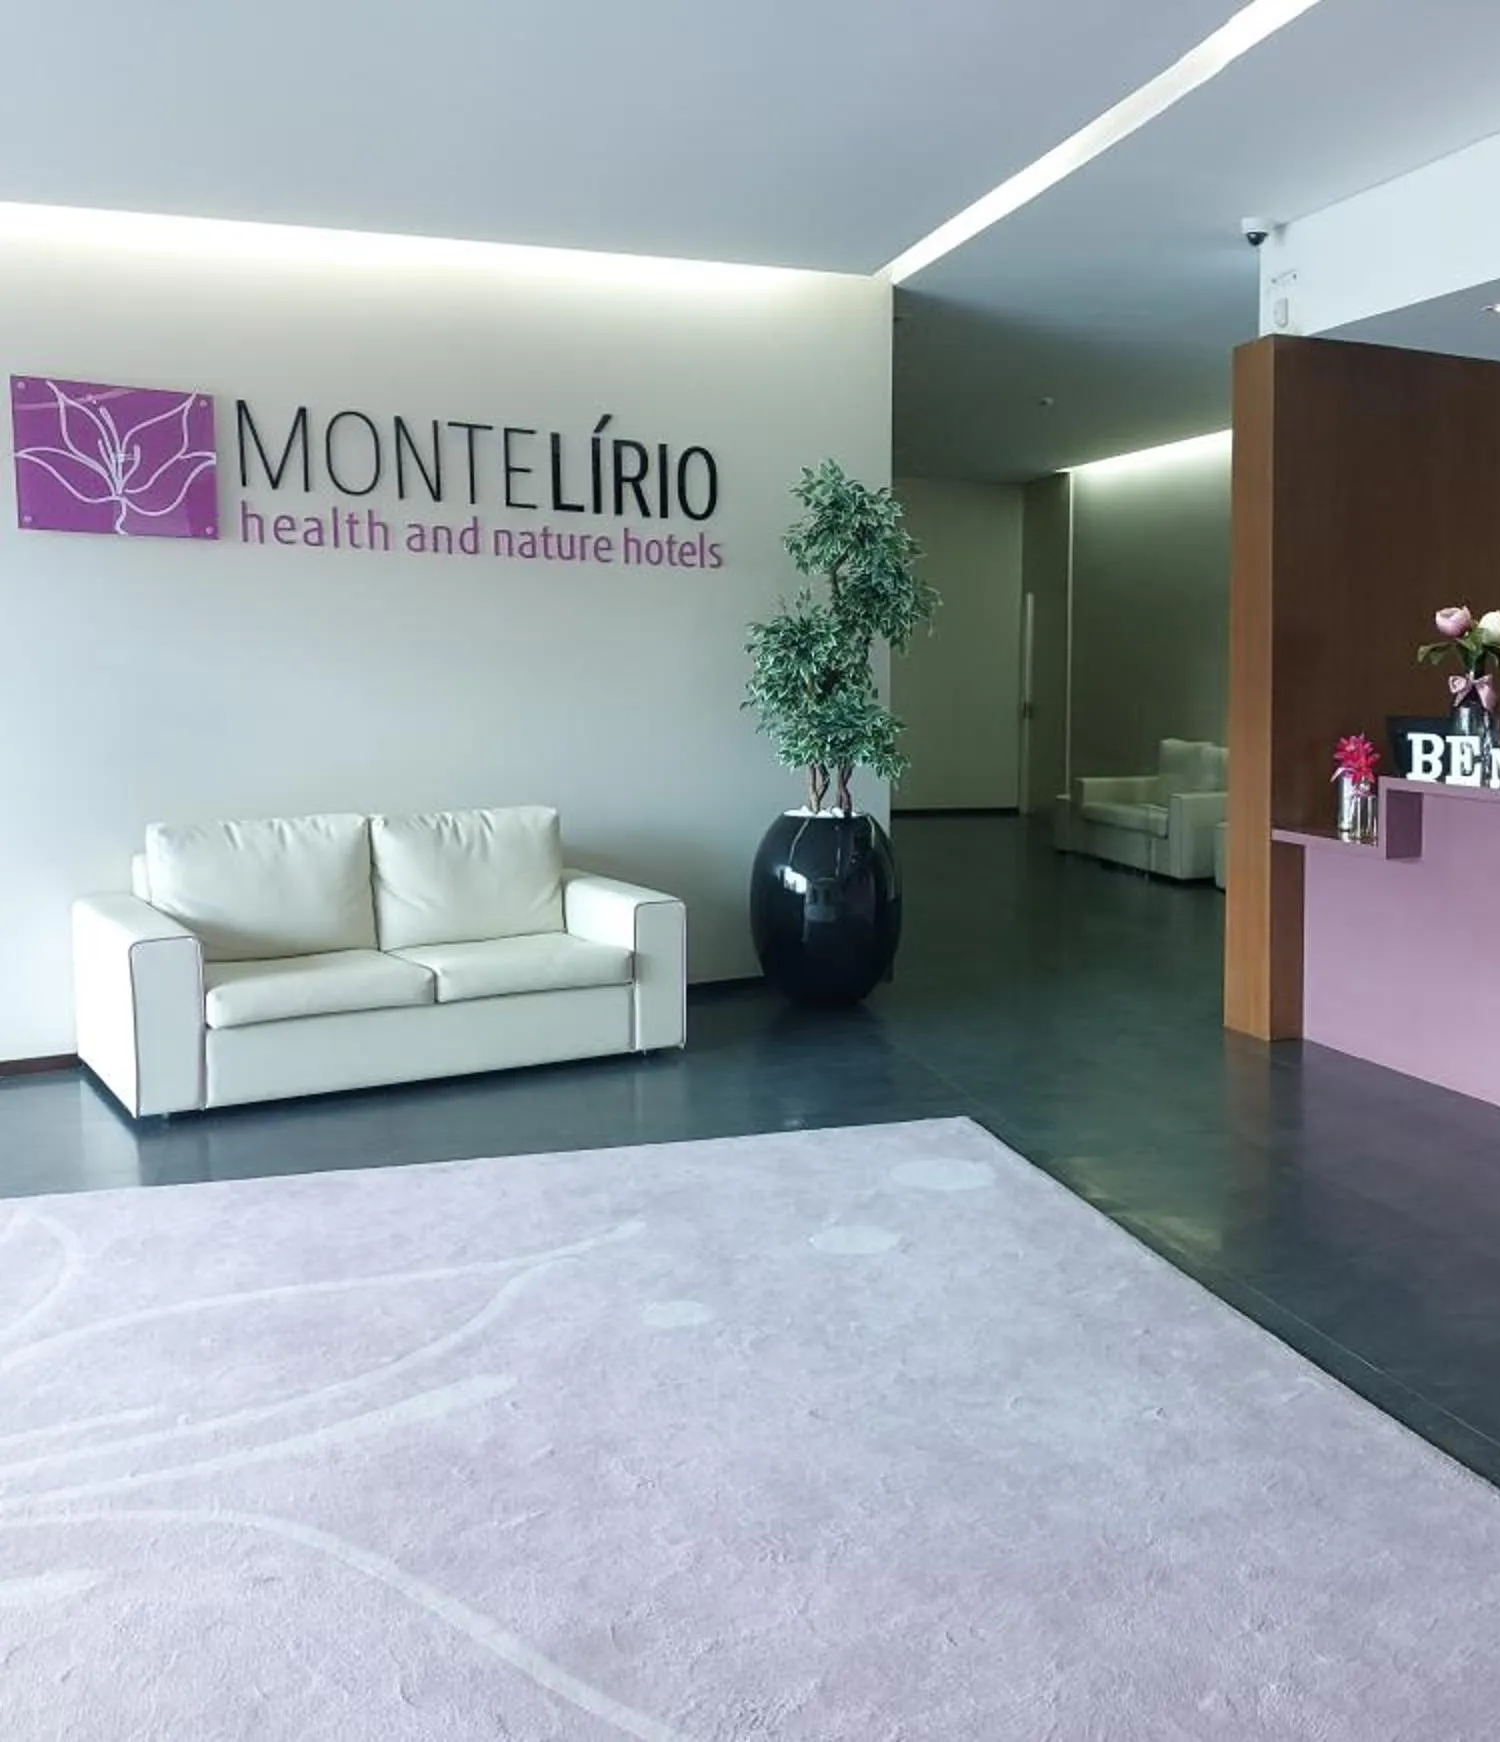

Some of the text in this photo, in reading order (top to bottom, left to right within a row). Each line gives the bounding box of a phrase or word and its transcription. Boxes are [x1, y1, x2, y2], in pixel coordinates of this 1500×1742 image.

[236, 399, 718, 521] MONTELÍRIO
[241, 499, 724, 569] health and nature hotels
